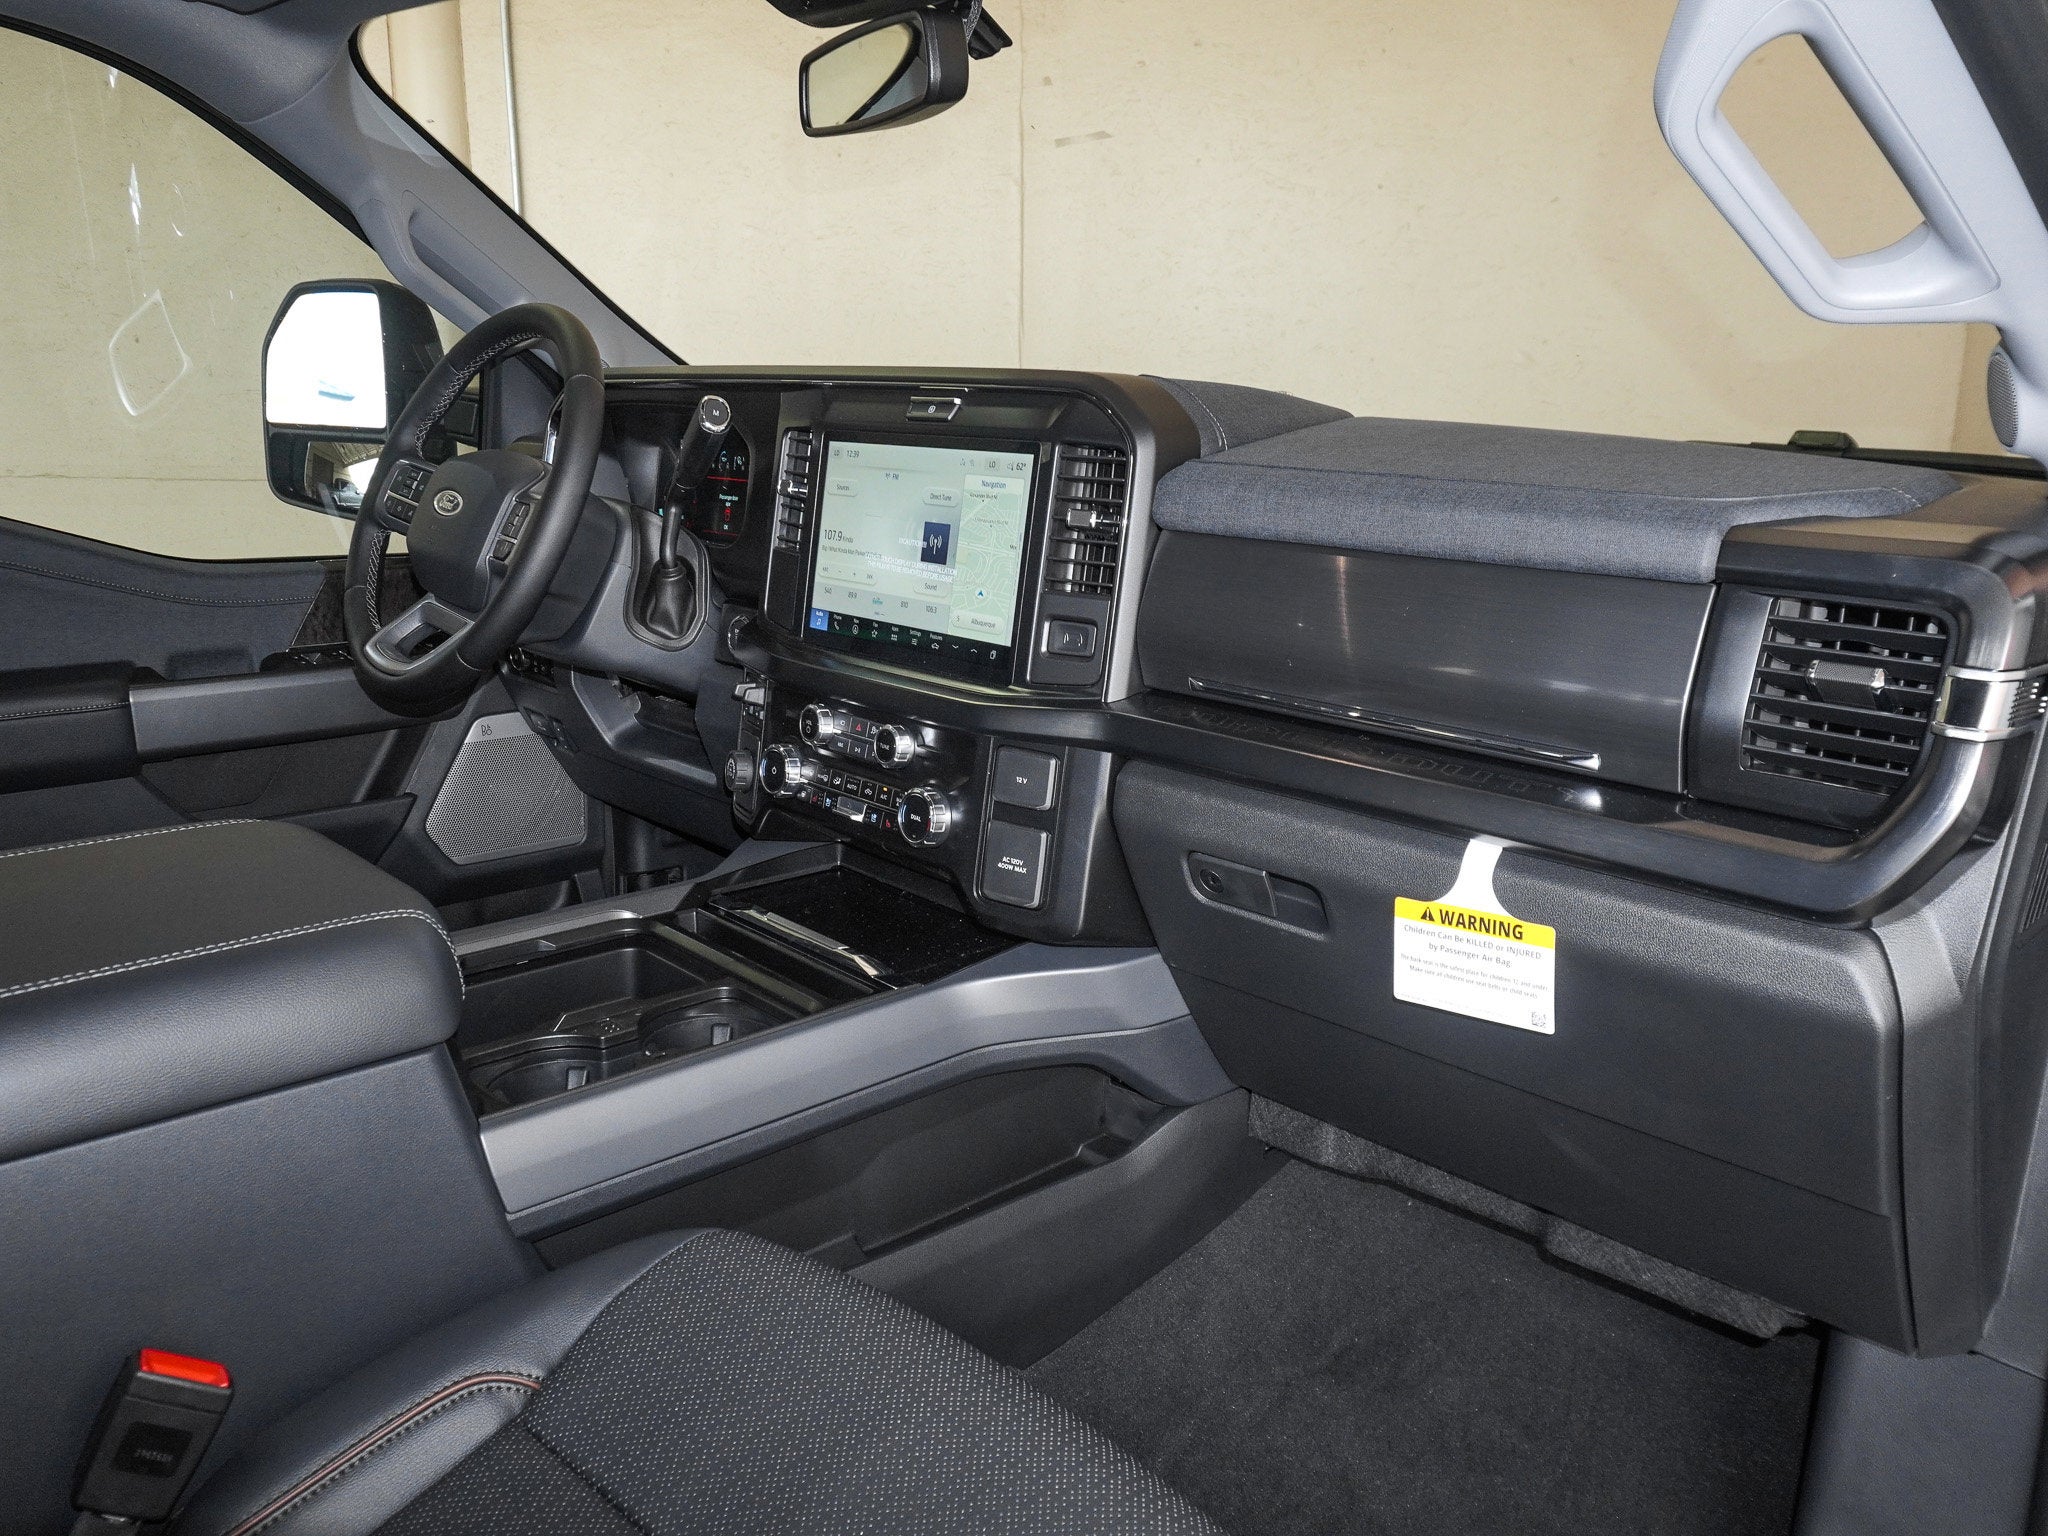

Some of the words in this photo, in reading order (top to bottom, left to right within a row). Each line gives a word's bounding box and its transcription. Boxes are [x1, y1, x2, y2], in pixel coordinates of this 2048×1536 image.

[981, 480, 1007, 489] Navigation
[824, 529, 843, 542] 107.9
[846, 783, 857, 791] AUTO
[910, 813, 922, 822] DUAL
[1014, 865, 1027, 873] MAX
[1439, 908, 1524, 941] WARNING
[1404, 924, 1436, 937] Children
[1437, 931, 1453, 941] Can
[1454, 935, 1464, 943] Be
[1466, 937, 1494, 950] KILLED
[1506, 946, 1542, 960] INJURED
[1428, 942, 1439, 952] by
[1440, 944, 1479, 960] Passenger
[1481, 953, 1493, 962] Air
